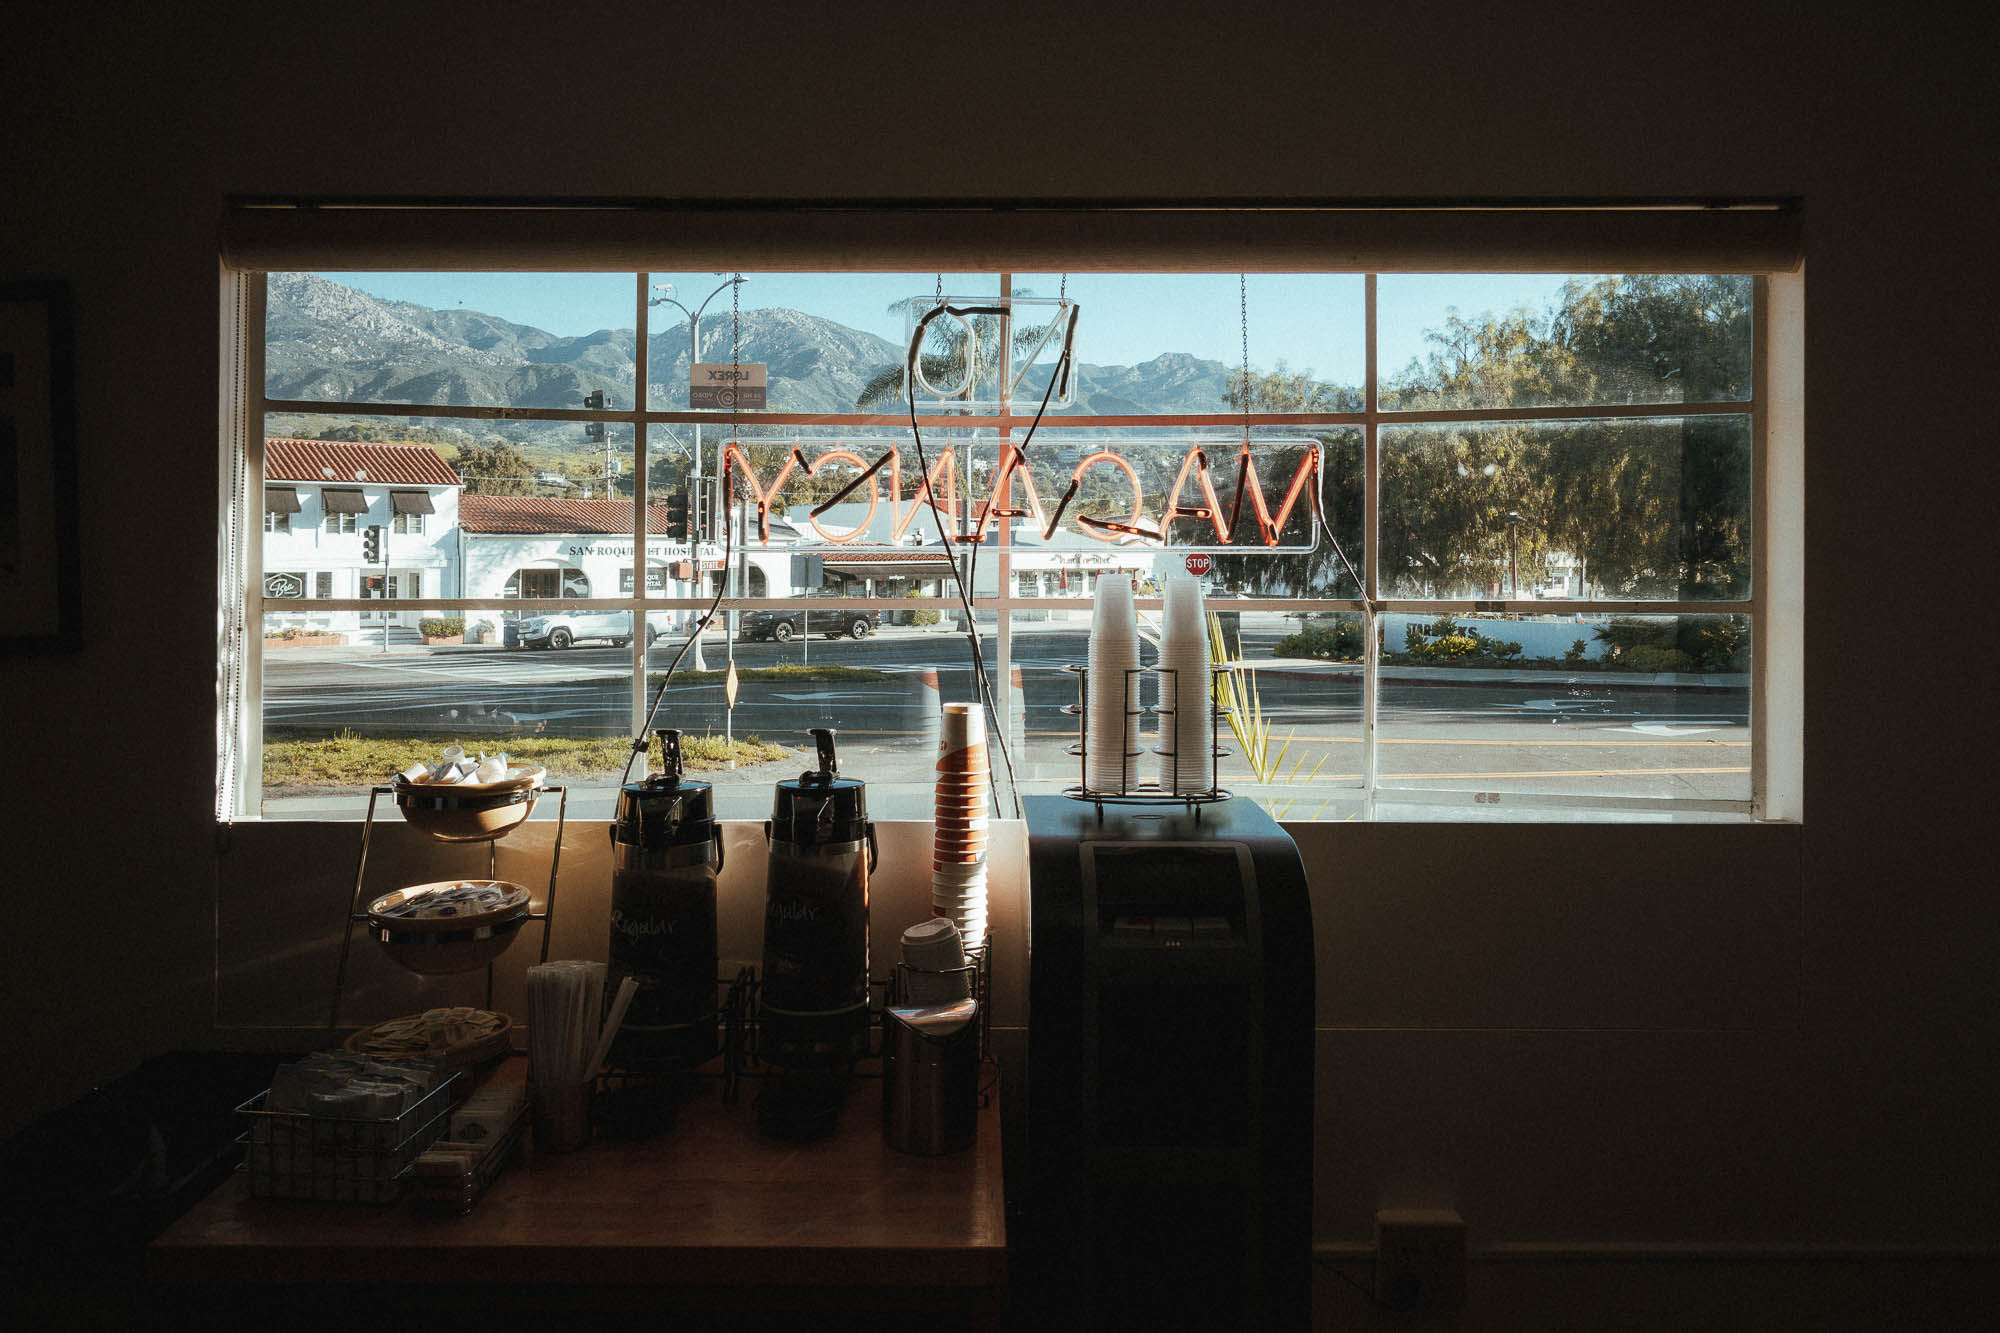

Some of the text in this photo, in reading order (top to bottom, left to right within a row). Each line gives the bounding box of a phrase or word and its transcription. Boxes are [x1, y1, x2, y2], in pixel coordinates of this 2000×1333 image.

[569, 546, 593, 556] SAN
[1186, 558, 1209, 569] STOP
[1406, 622, 1478, 639] STARKS
